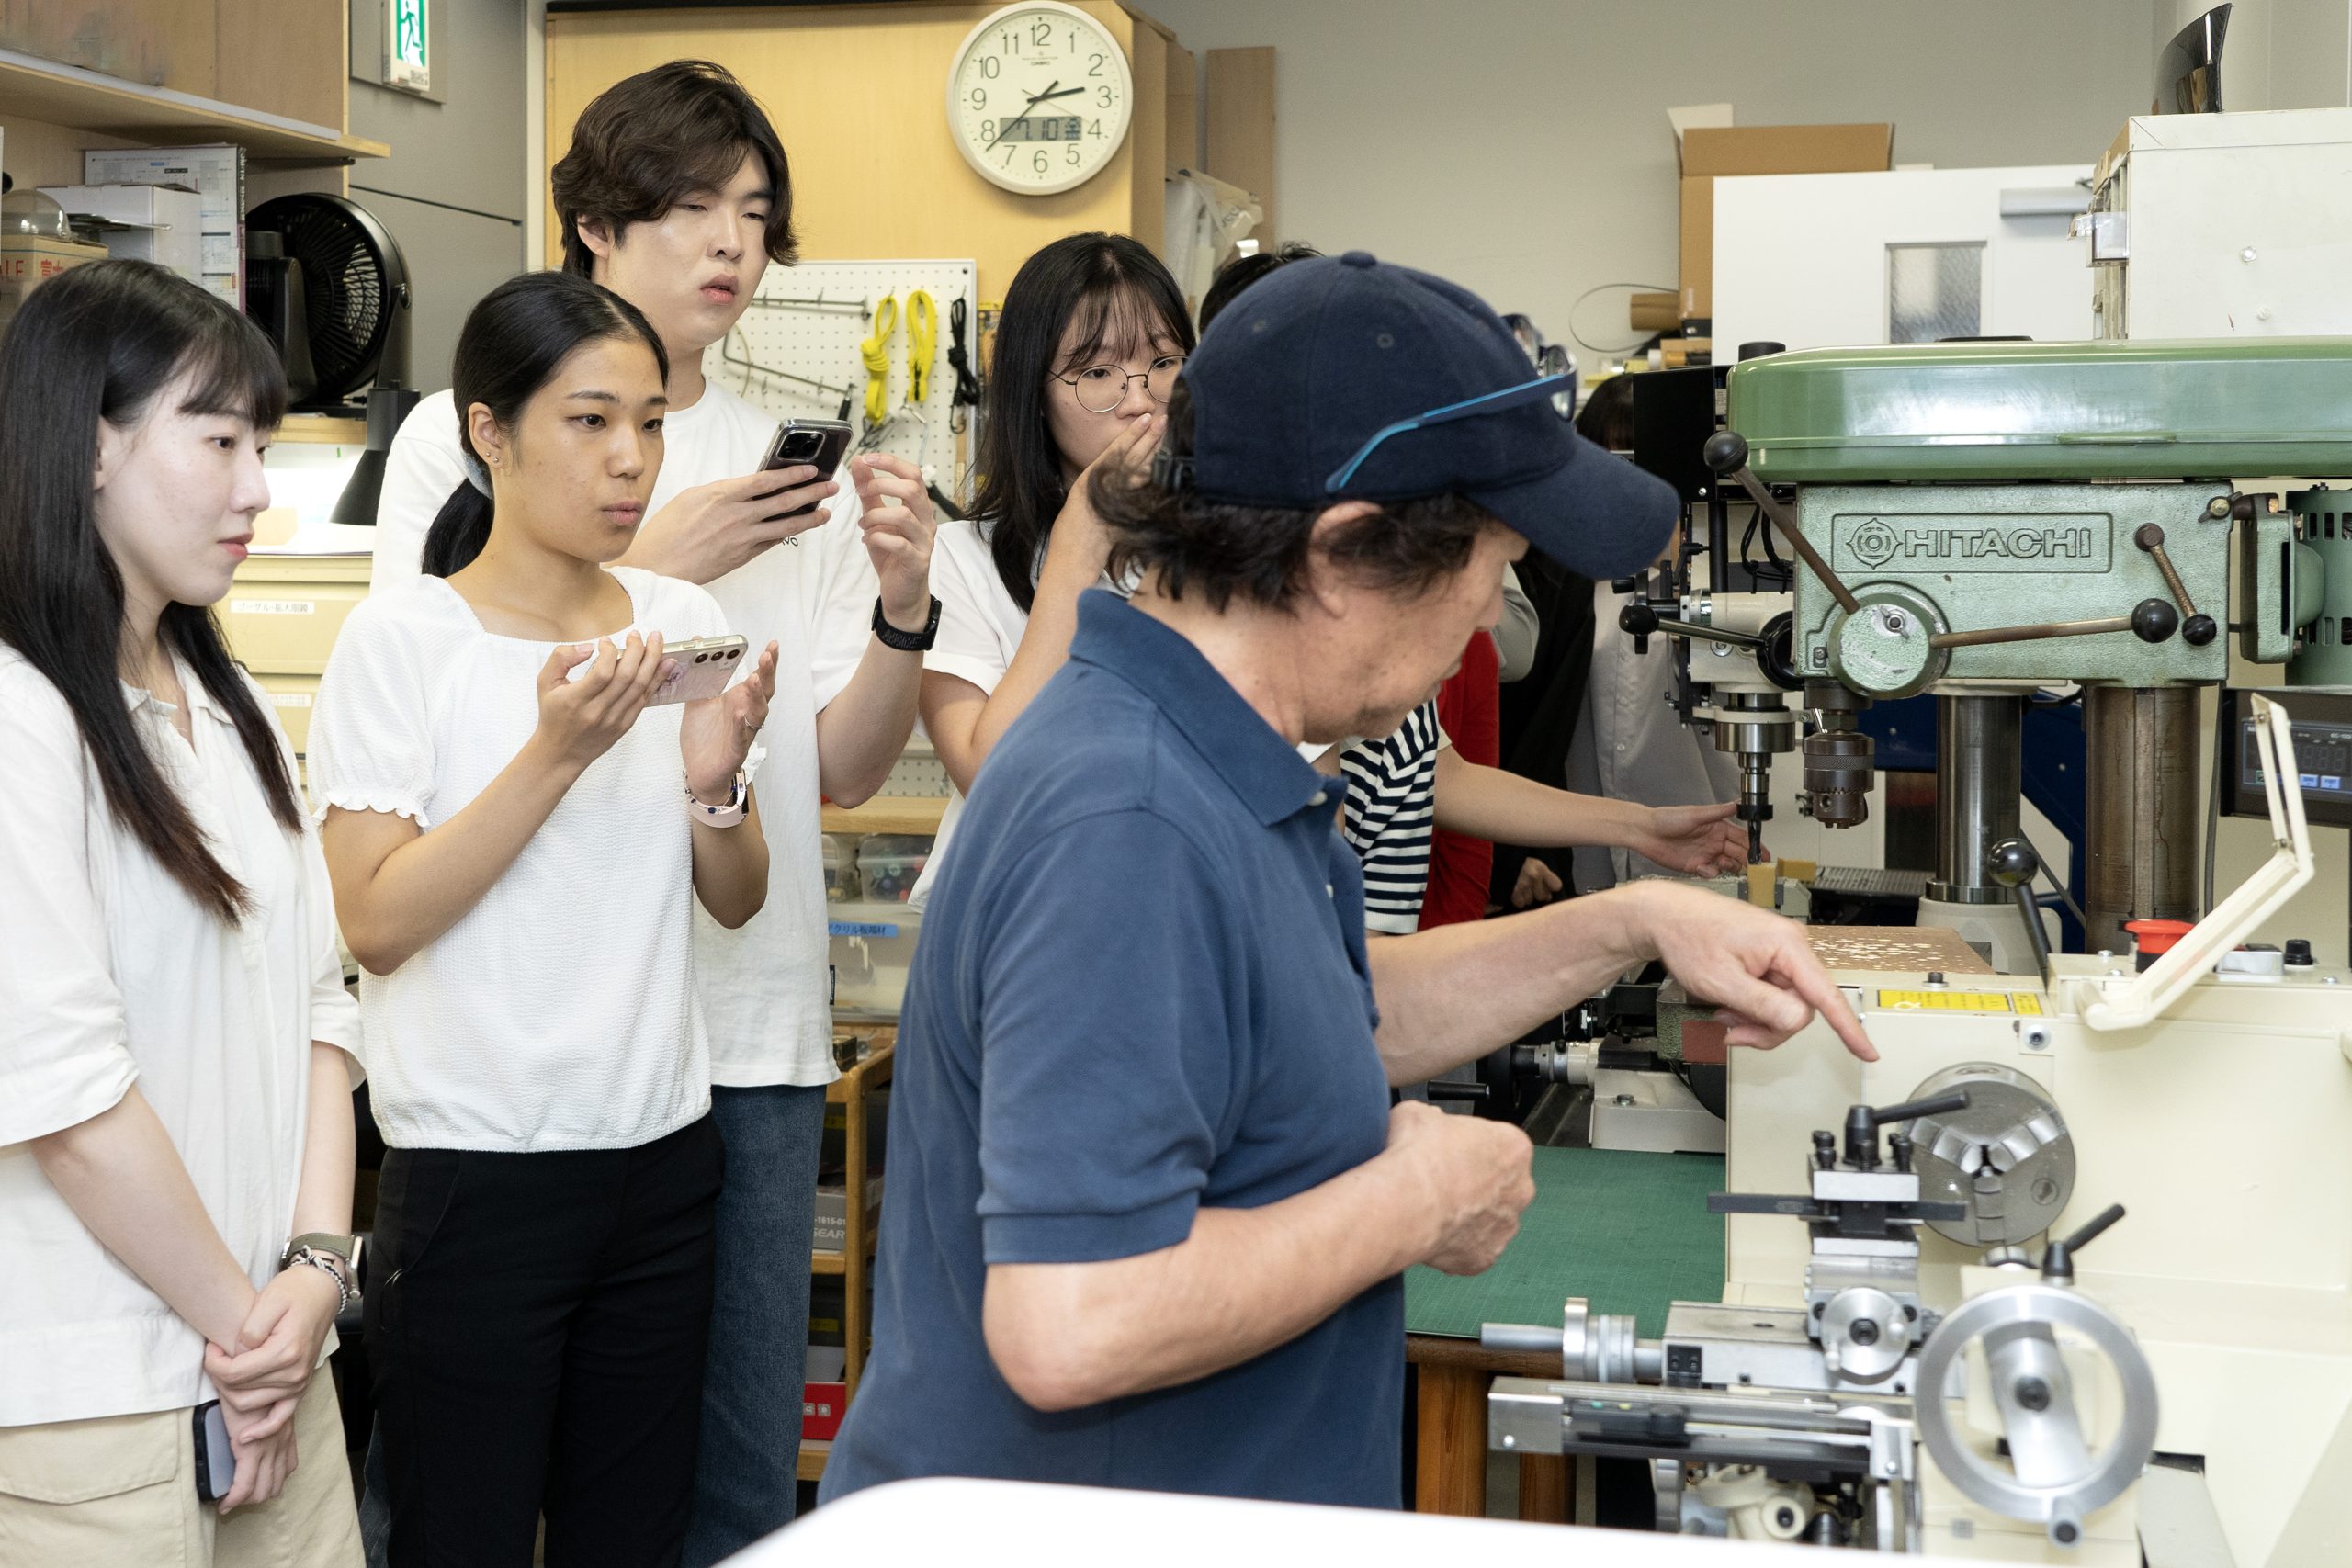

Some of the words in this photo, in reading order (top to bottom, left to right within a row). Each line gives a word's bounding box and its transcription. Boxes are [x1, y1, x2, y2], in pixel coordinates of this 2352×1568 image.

[1003, 33, 1018, 54] 11
[1031, 23, 1051, 46] 12
[1069, 32, 1075, 53] 1
[978, 56, 1000, 79] 10
[1088, 53, 1103, 76] 2
[971, 87, 987, 111] 9
[1097, 85, 1112, 108] 3
[980, 119, 995, 142] 8
[1087, 118, 1102, 139] 4
[1003, 144, 1017, 166] 7
[1033, 150, 1048, 173] 6
[1065, 143, 1080, 165] 5
[1905, 528, 2091, 558] HITACHI
